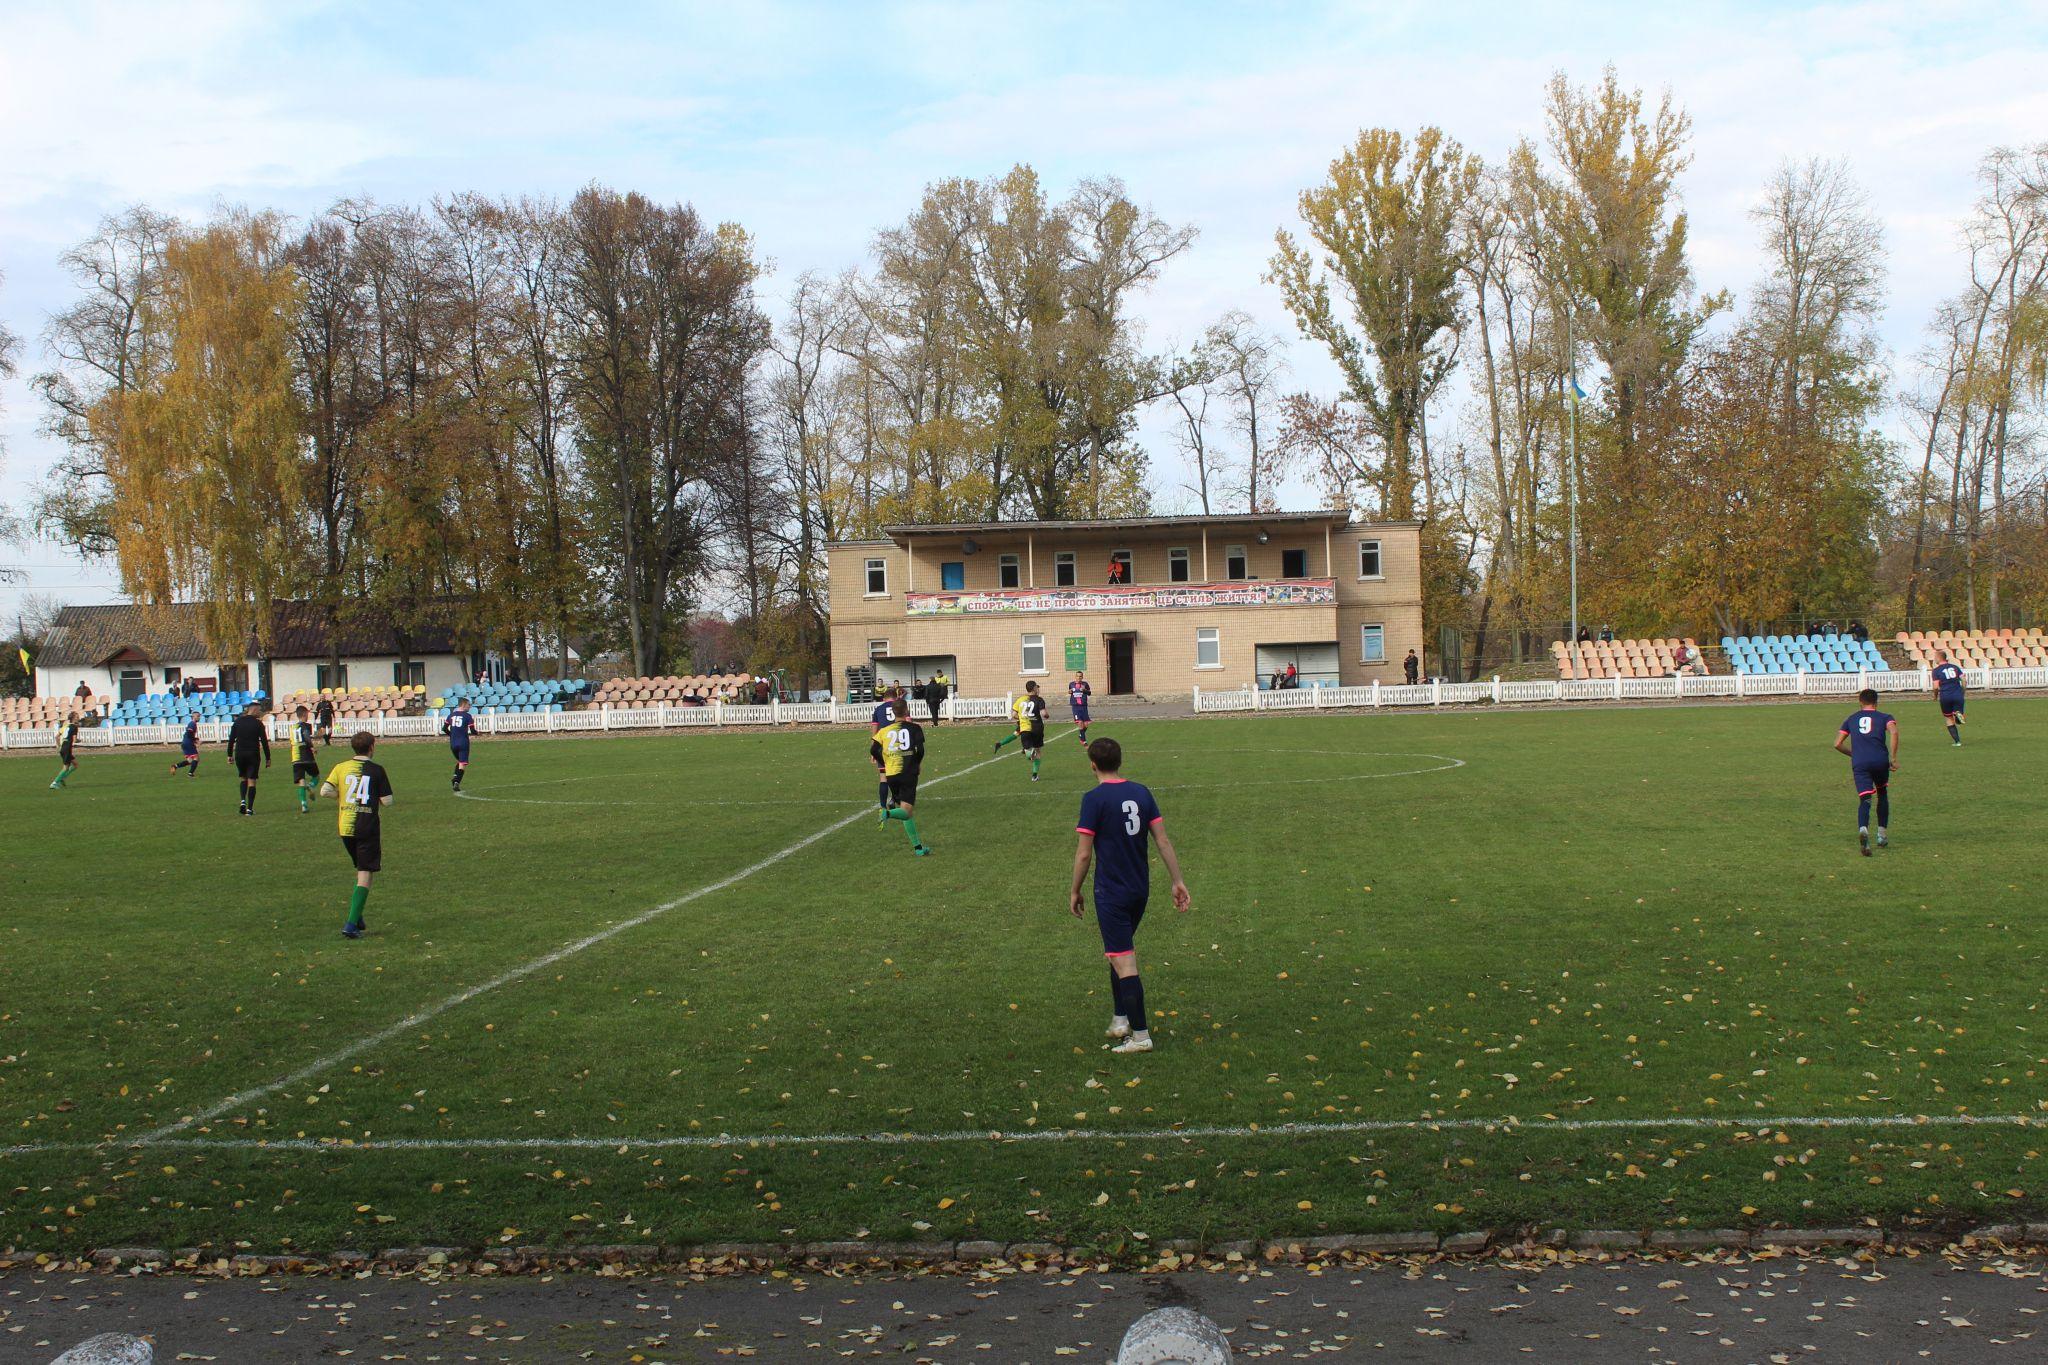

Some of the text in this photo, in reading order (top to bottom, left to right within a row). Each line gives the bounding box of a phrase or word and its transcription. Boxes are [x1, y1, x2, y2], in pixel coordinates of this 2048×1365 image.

[967, 601, 1004, 611] СПОРТ
[1017, 600, 1032, 609] ЦЕ
[1039, 599, 1051, 608] НЕ
[1054, 598, 1097, 608] ПРОСТО
[1157, 595, 1173, 606] ЦЕ
[1175, 594, 1213, 604] СТИЛЬ
[1216, 592, 1261, 603] ЖИТТЯ!
[1942, 667, 1956, 680] 16
[885, 707, 895, 721] 5
[1020, 701, 1035, 717] 22
[451, 715, 463, 728] 15
[1858, 716, 1872, 734] 9
[886, 728, 911, 751] 29
[345, 774, 371, 805] 24
[1121, 800, 1141, 836] 3
